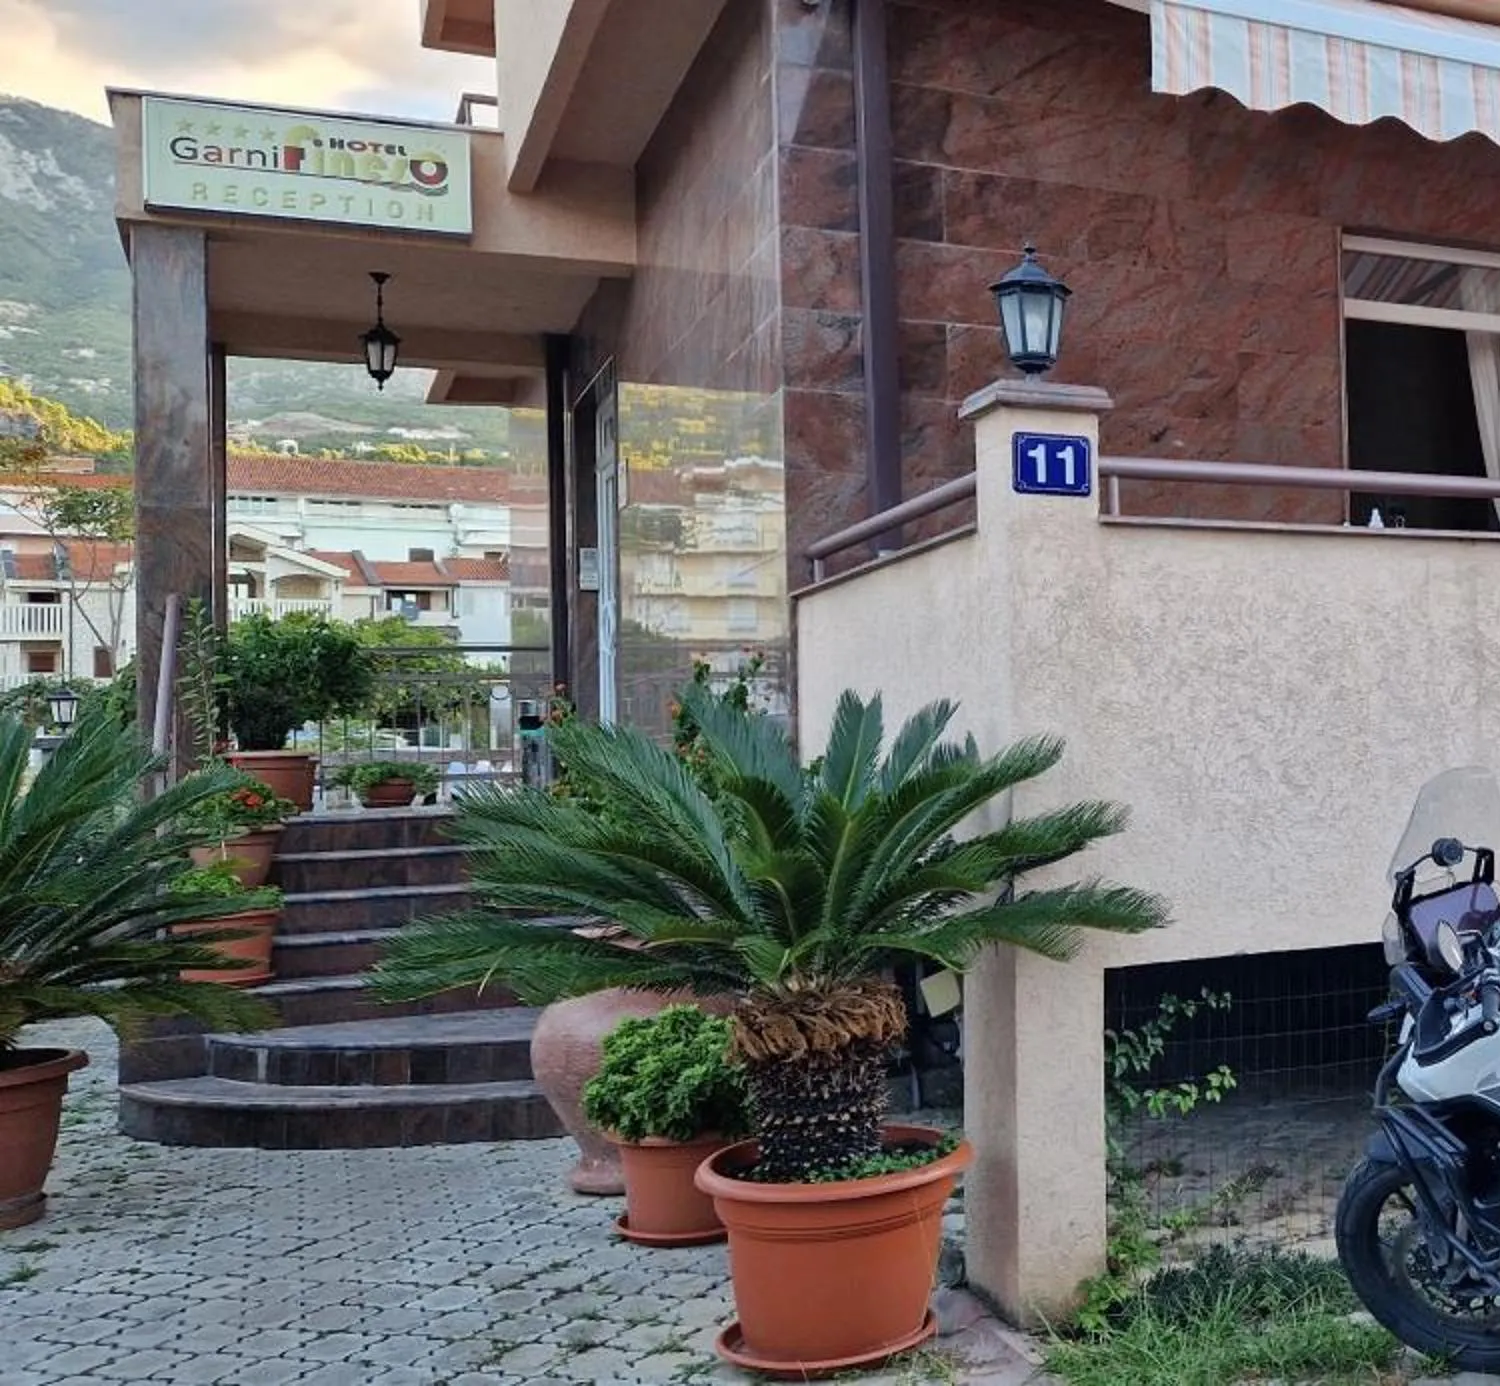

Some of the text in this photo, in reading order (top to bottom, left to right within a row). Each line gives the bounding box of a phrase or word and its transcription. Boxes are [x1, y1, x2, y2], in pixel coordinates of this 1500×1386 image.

[169, 136, 279, 169] Garni
[329, 137, 407, 157] HOTEL
[191, 181, 435, 223] RECEPTION
[1027, 443, 1075, 485] 11
